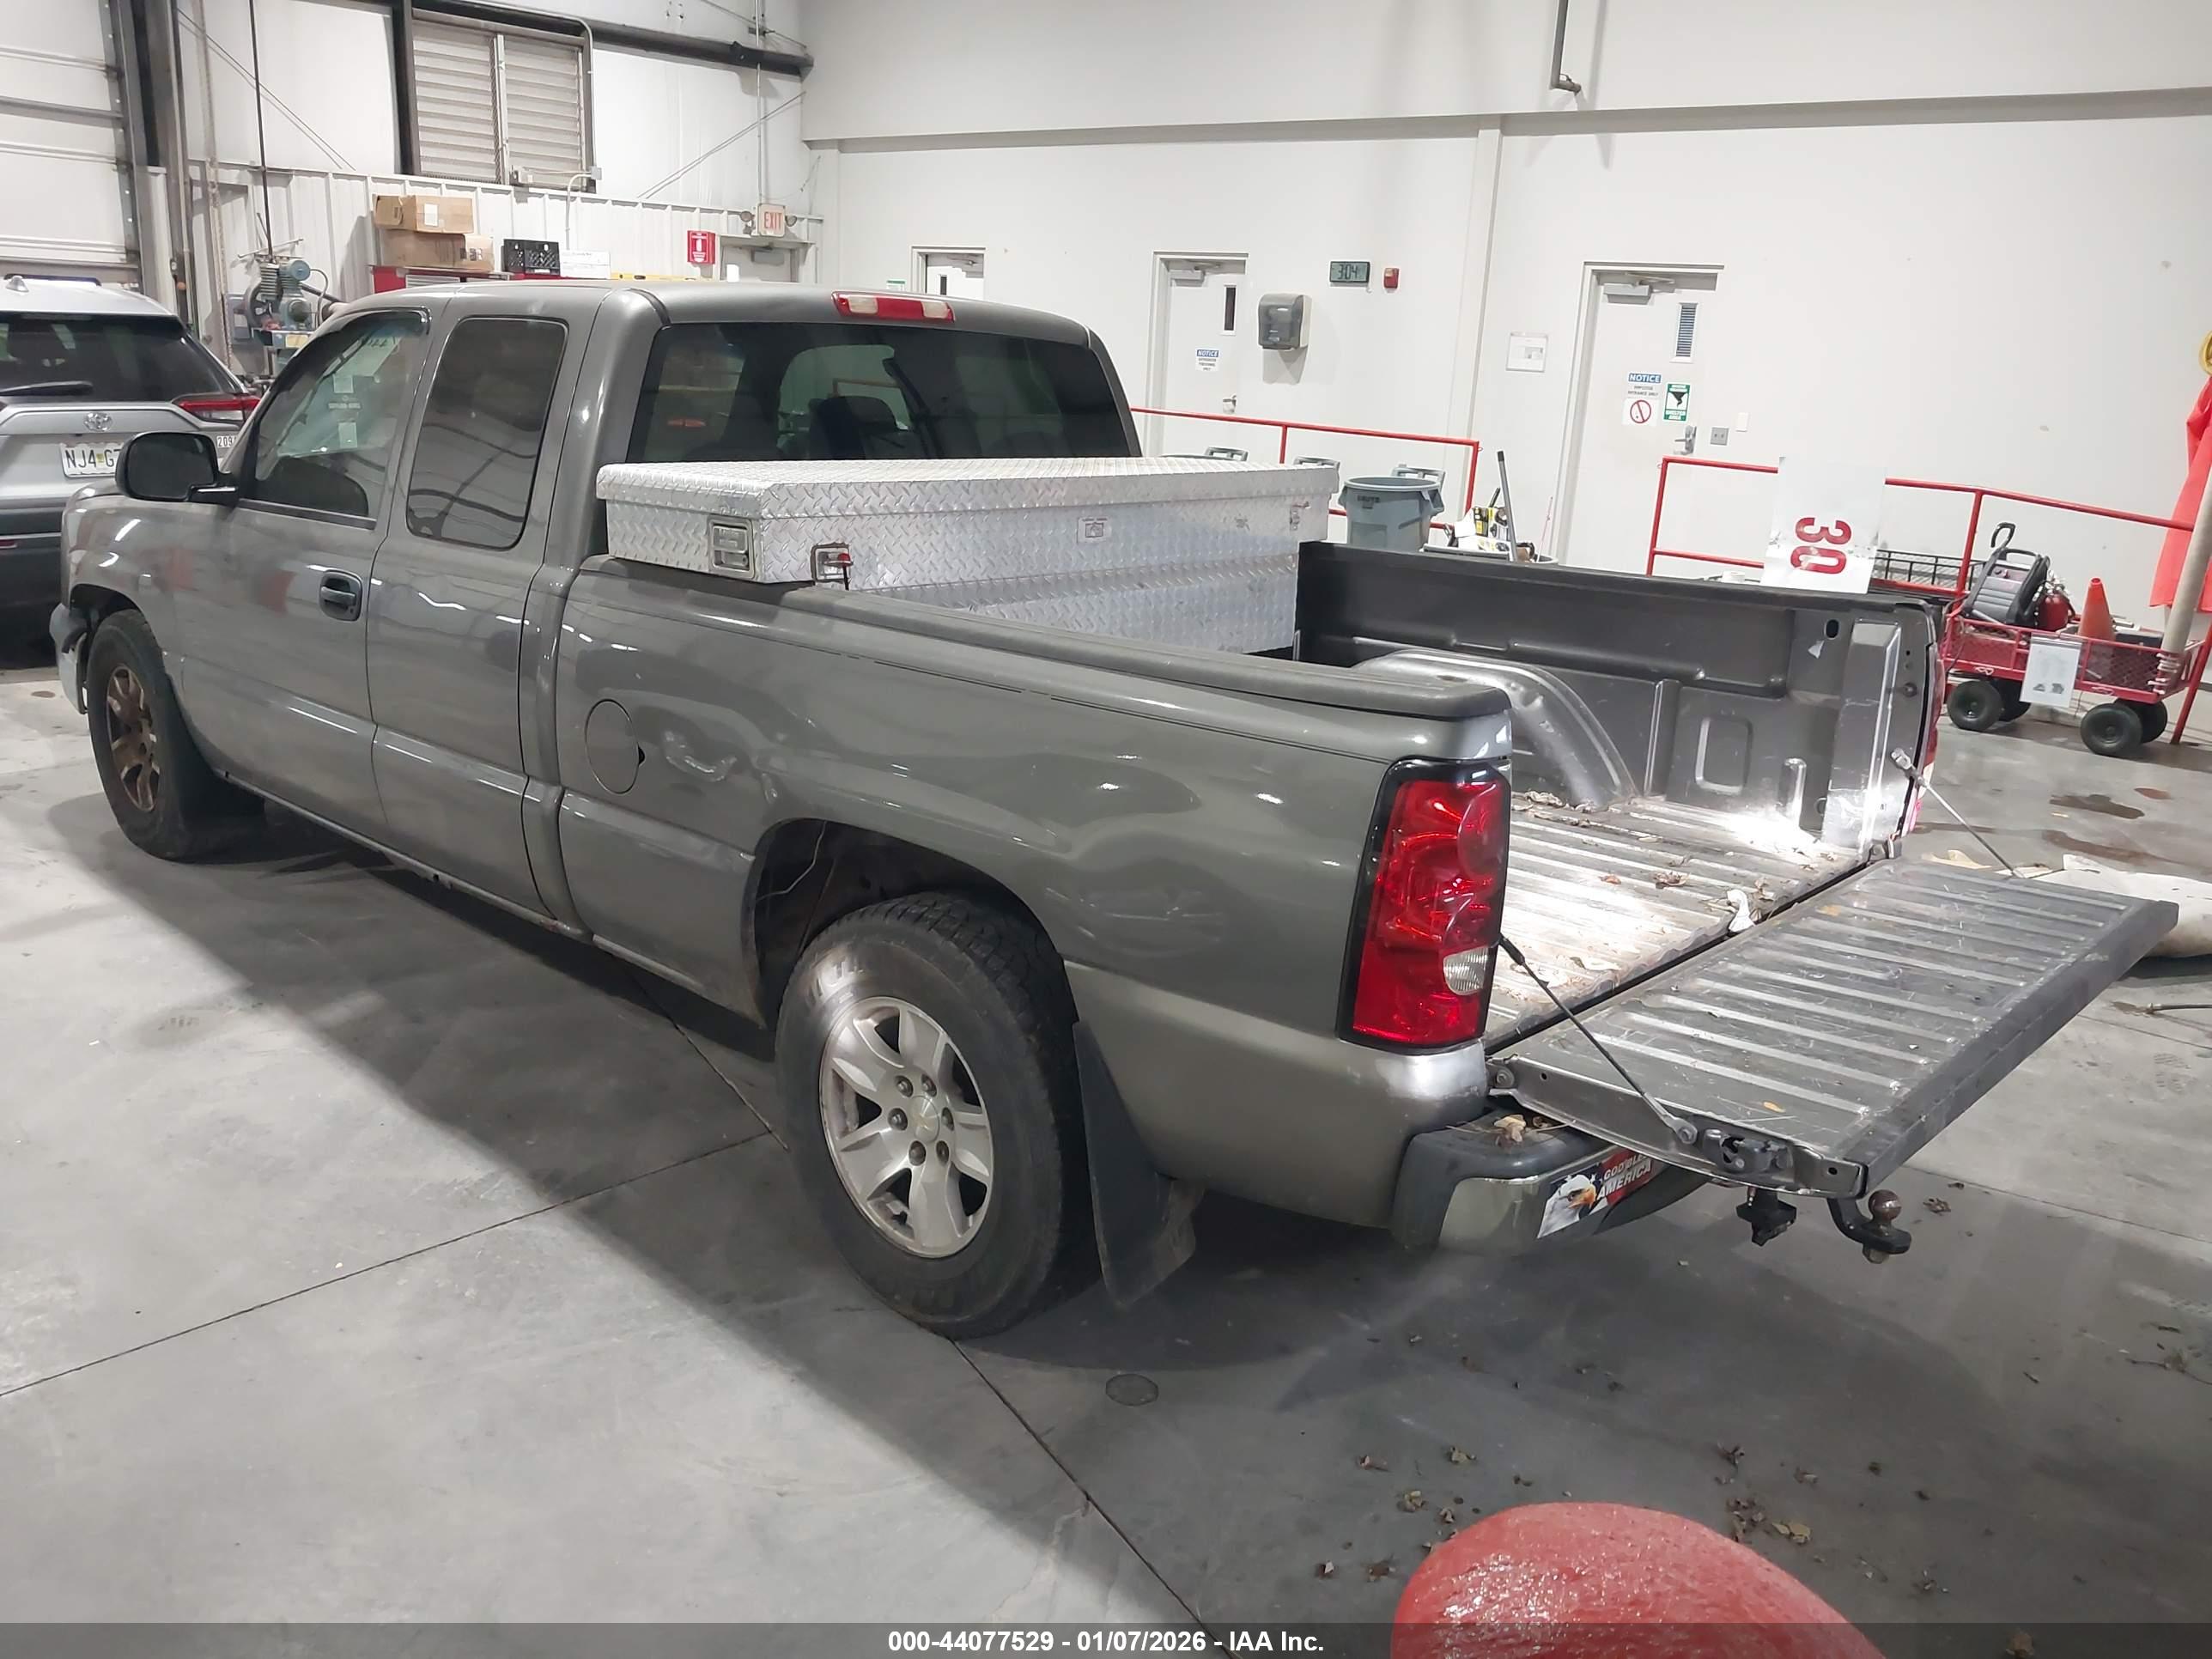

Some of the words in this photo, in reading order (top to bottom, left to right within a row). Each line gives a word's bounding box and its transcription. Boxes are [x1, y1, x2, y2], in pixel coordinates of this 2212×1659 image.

[763, 211, 782, 231] EXIT
[1629, 374, 1660, 383] NOTICE
[217, 435, 236, 447] 209
[1790, 517, 1852, 574] 30
[1595, 1158, 1652, 1200] AMERICA
[1603, 1162, 1627, 1181] GOD
